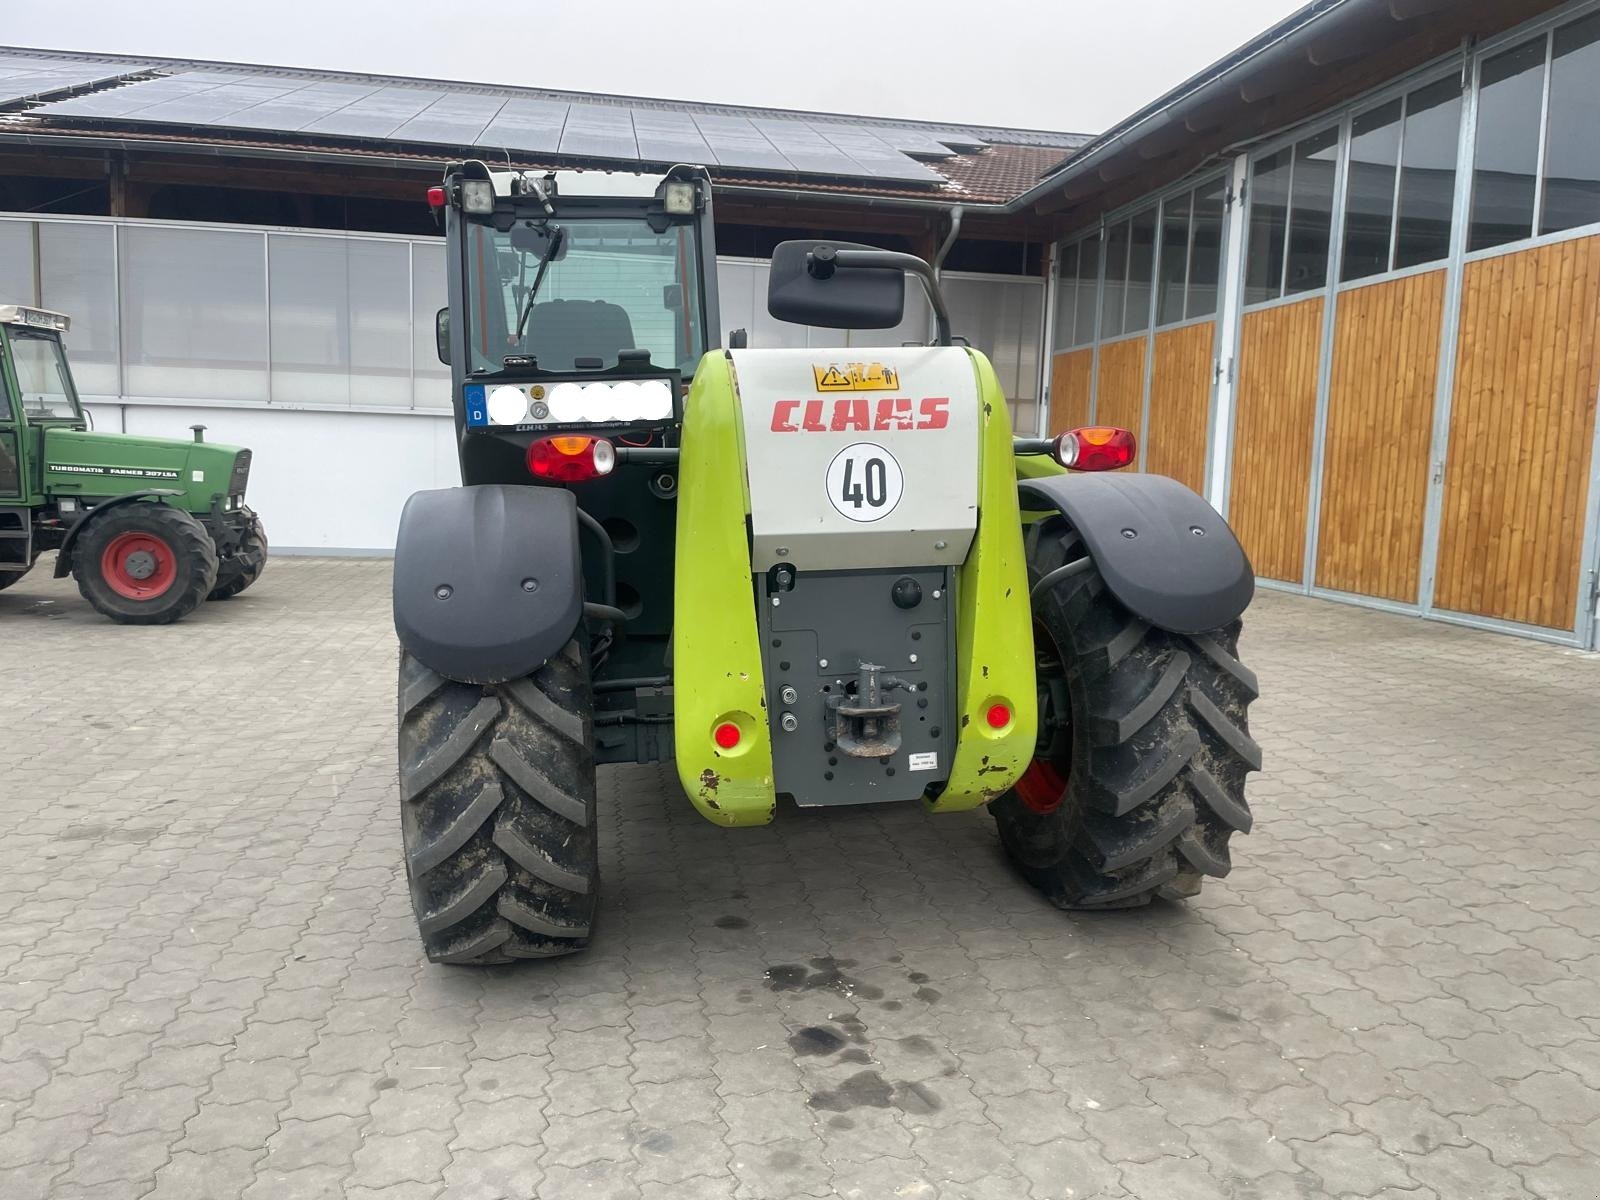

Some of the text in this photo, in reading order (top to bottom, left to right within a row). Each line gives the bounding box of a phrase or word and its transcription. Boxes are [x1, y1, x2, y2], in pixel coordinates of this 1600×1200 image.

[474, 411, 482, 420] D
[771, 398, 949, 432] CLAAS
[50, 465, 104, 474] TURBOMATIK
[843, 458, 887, 508] 40
